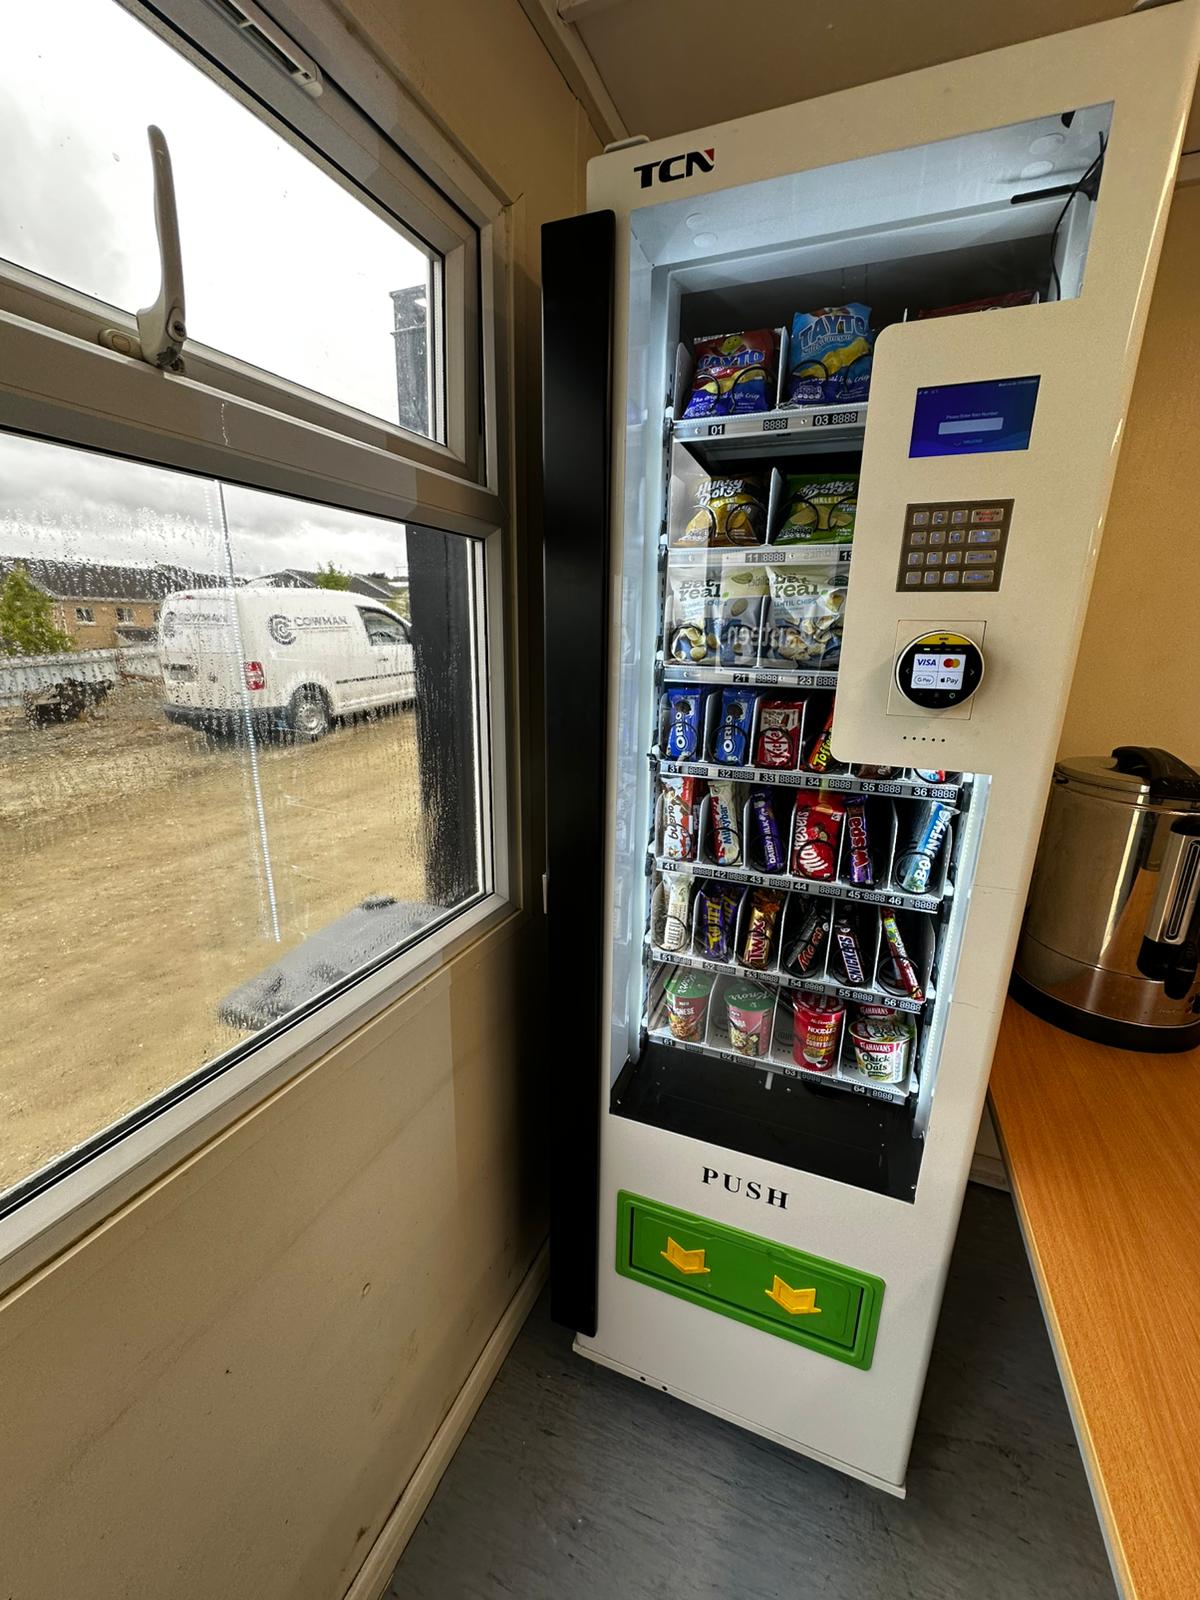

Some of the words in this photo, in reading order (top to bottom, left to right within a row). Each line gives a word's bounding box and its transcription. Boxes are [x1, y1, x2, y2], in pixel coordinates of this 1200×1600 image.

[634, 148, 715, 189] TCN
[800, 314, 868, 349] TAYTO
[711, 425, 723, 434] 01
[815, 415, 829, 425] 03
[832, 413, 857, 424] 8888
[695, 480, 743, 497] Hunky
[746, 554, 759, 562] 11
[680, 584, 720, 601] real
[774, 583, 819, 598] real
[294, 616, 348, 626] COWMAN
[800, 676, 812, 684] 23
[720, 769, 731, 778] 32
[762, 773, 775, 782] 33
[807, 778, 820, 786] 34
[862, 783, 875, 791] 35
[878, 784, 901, 793] 8888
[914, 787, 928, 796] 36
[931, 789, 956, 798] 8888
[913, 818, 947, 878] BOUNTY
[715, 872, 726, 880] 42
[848, 891, 861, 899] 45
[888, 897, 902, 905] 46
[748, 920, 766, 961] TWIX
[838, 934, 864, 983] SNICKERS
[838, 989, 851, 997] 55
[884, 998, 897, 1006] 56
[862, 1052, 889, 1062] Quick
[865, 1062, 887, 1071] Oats
[853, 1085, 866, 1093] 64
[701, 1166, 789, 1210] PUSH
